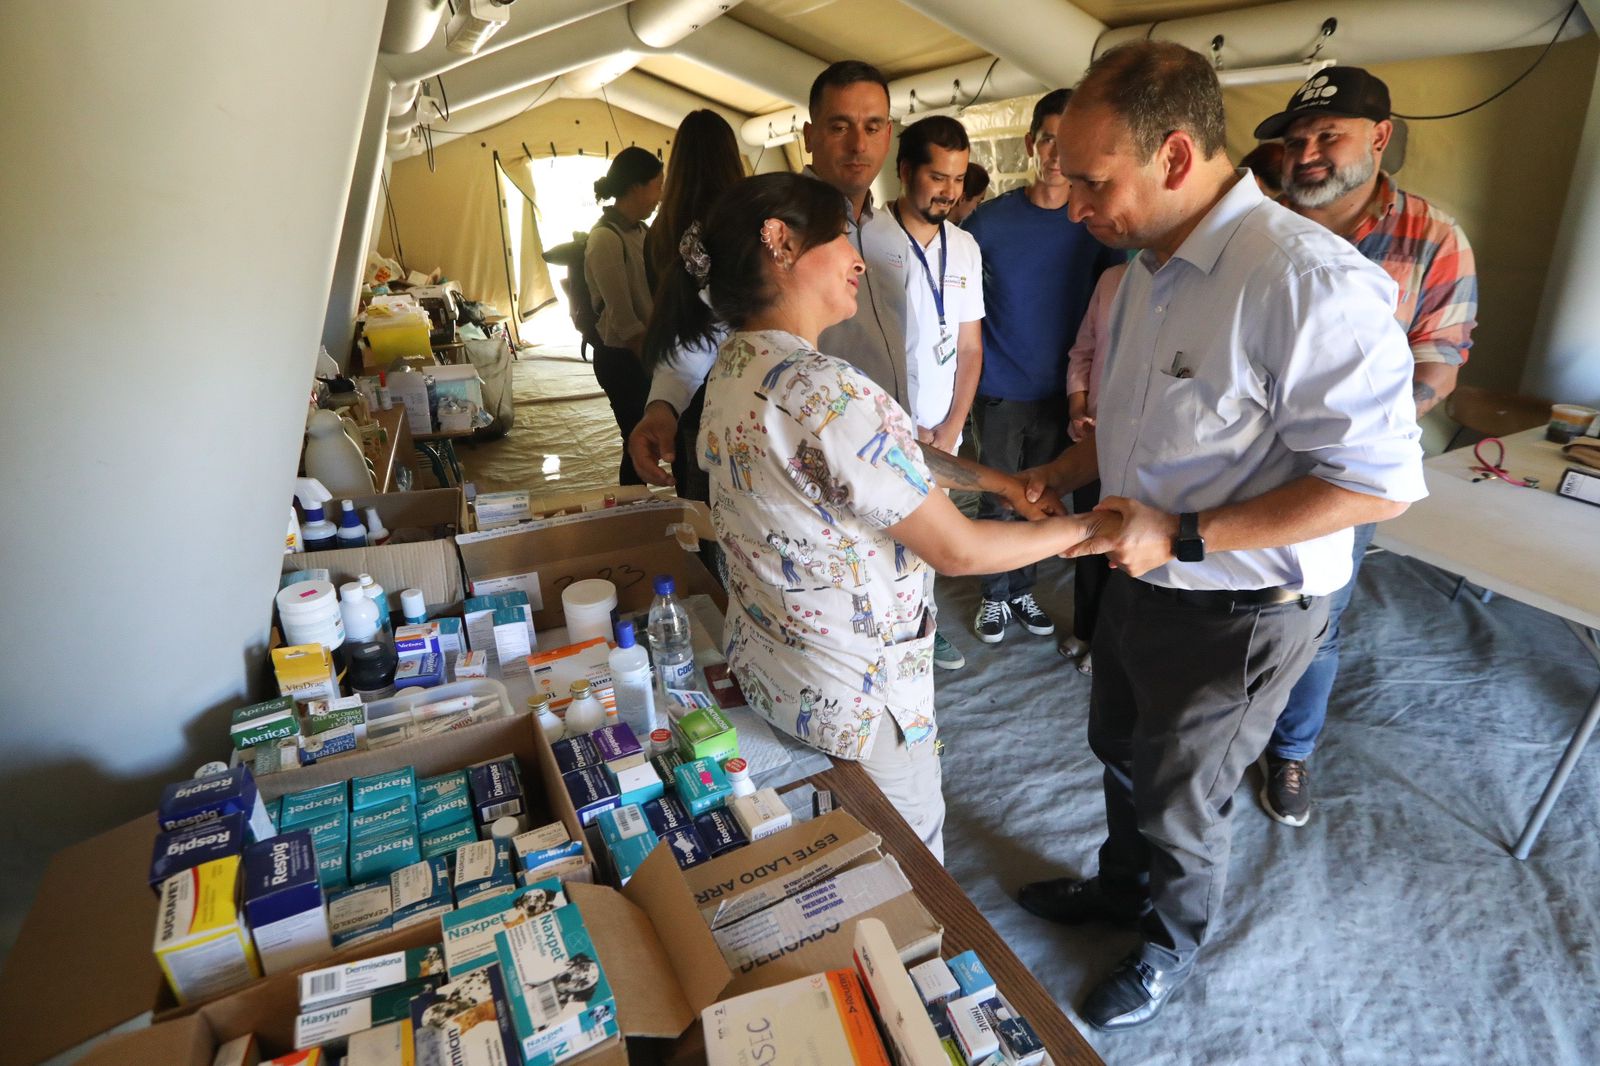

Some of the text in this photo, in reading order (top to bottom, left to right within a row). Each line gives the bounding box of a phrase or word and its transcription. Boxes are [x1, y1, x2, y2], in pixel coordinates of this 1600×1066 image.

[175, 777, 233, 798] Respig
[358, 776, 411, 795] Naxpet
[287, 794, 344, 815] Naxpet
[353, 804, 408, 827] Naxpet
[421, 796, 468, 820] Naxpet
[658, 798, 679, 829] Rostrum
[164, 809, 219, 831] Respig
[711, 811, 732, 844] Rostrum
[167, 830, 231, 856] Respig
[355, 837, 414, 860] Naxpet
[422, 827, 472, 848] Naxpet
[792, 833, 840, 862] ESTE
[272, 842, 290, 886] Respig
[740, 856, 792, 884] LADO
[161, 880, 180, 942] SUCRAVET
[448, 913, 507, 941] Naxpet
[540, 914, 566, 963] Naxpet
[344, 956, 403, 976] Dermisolona
[301, 1006, 350, 1028] Hasyun
[970, 1005, 990, 1033] THRIVE
